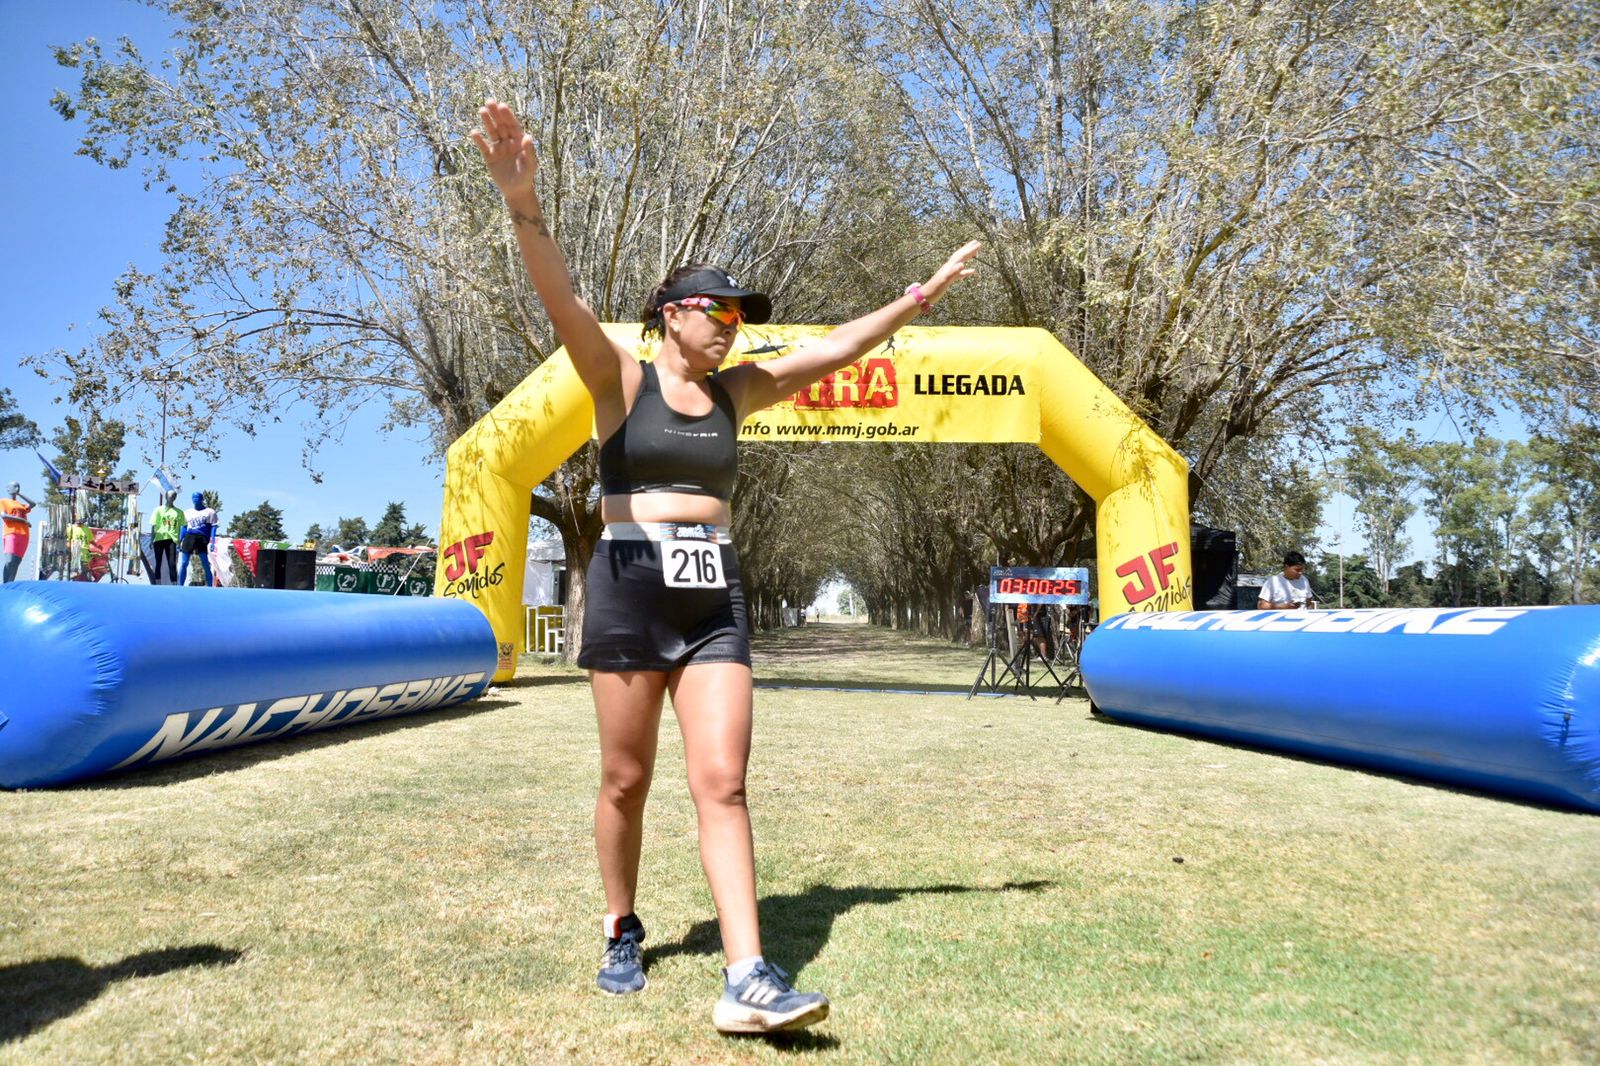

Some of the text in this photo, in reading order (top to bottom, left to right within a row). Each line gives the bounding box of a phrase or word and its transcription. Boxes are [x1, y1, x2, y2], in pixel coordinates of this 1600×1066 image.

[914, 375, 1025, 395] LLEGADA
[742, 422, 918, 438] nfo www.mmj.gob.ar
[444, 532, 493, 582] JF
[671, 548, 717, 584] 216
[1116, 542, 1178, 604] JF
[444, 563, 505, 599] Sonidos
[999, 577, 1077, 596] 03:00:25
[109, 672, 485, 769] NACHOSBIKE
